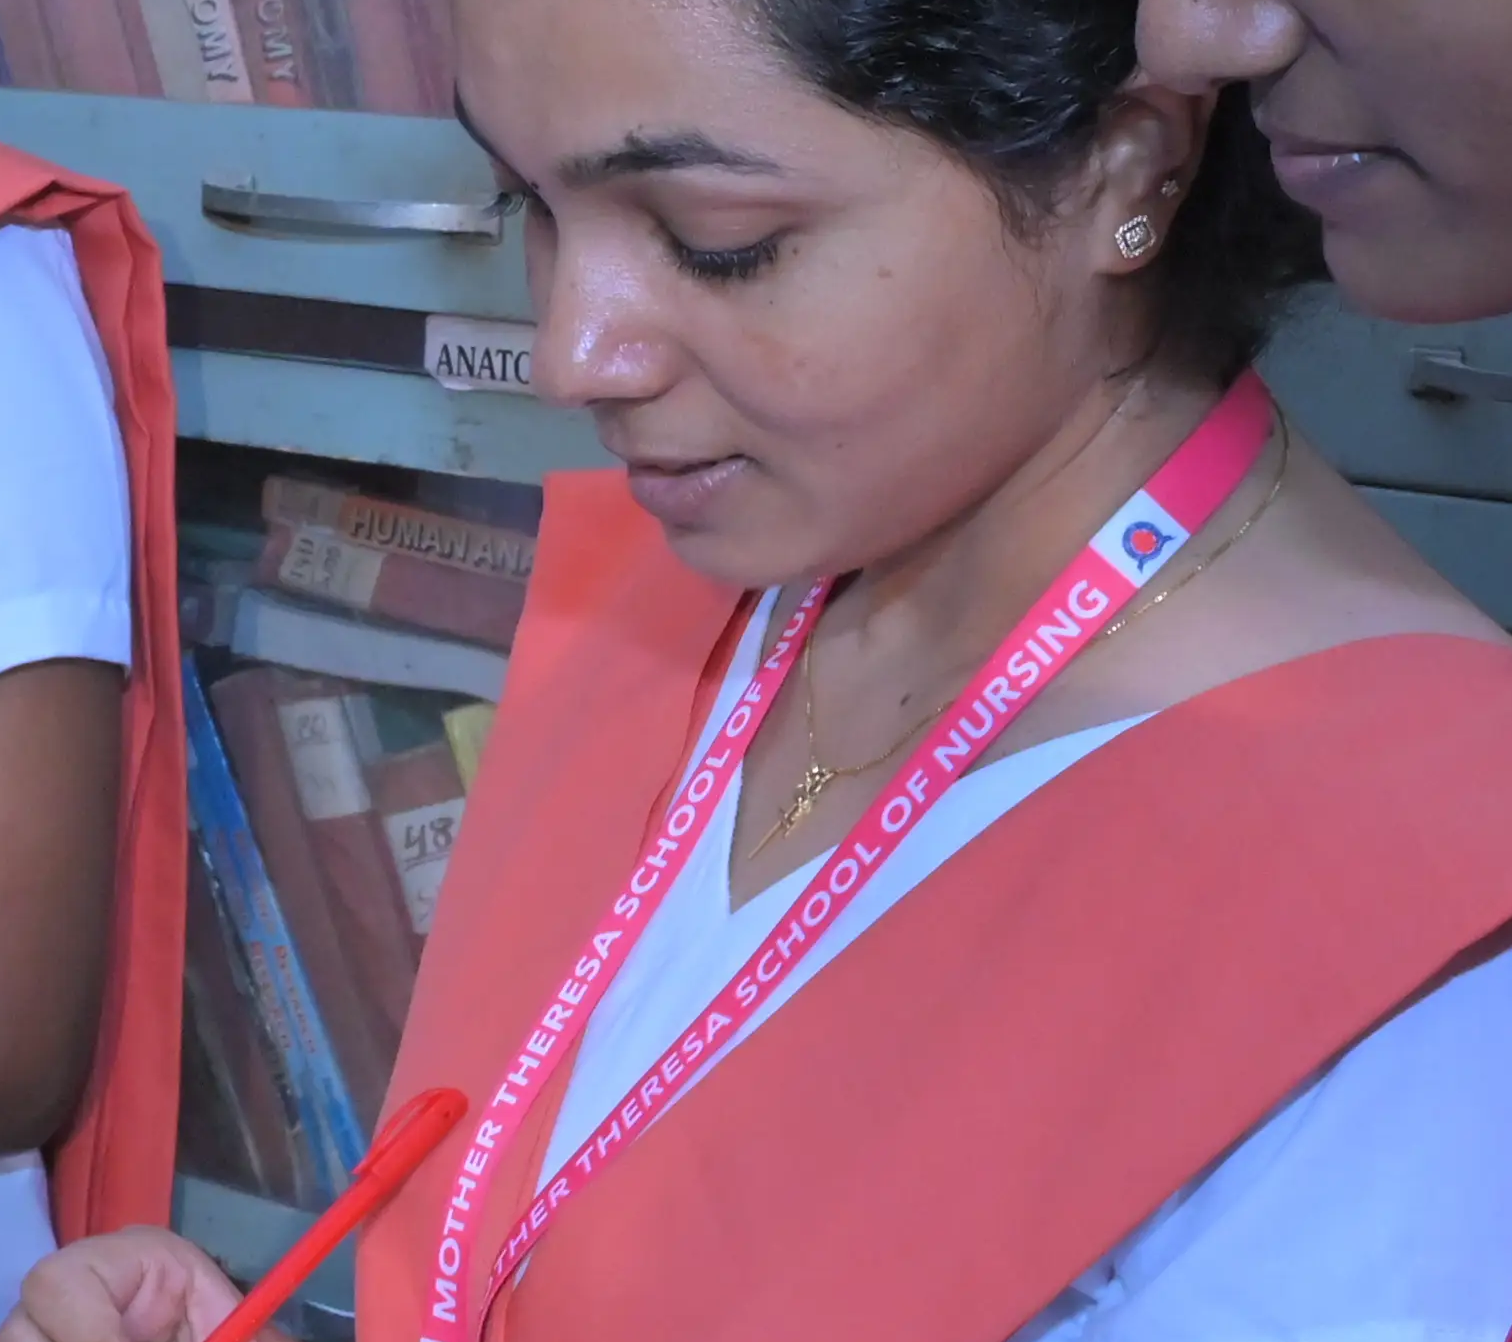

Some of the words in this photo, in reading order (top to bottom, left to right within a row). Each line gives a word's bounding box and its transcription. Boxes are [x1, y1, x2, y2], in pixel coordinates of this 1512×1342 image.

[349, 505, 470, 562] HUMAN
[432, 1119, 502, 1324] MOTHER
[491, 928, 623, 1109] THERESA
[613, 738, 730, 923] SCHOOL
[721, 677, 769, 739] OF
[575, 1011, 731, 1175] THERESA
[733, 839, 882, 1009] SCHOOL
[877, 768, 934, 843] OF
[932, 578, 1113, 772] NURSING
